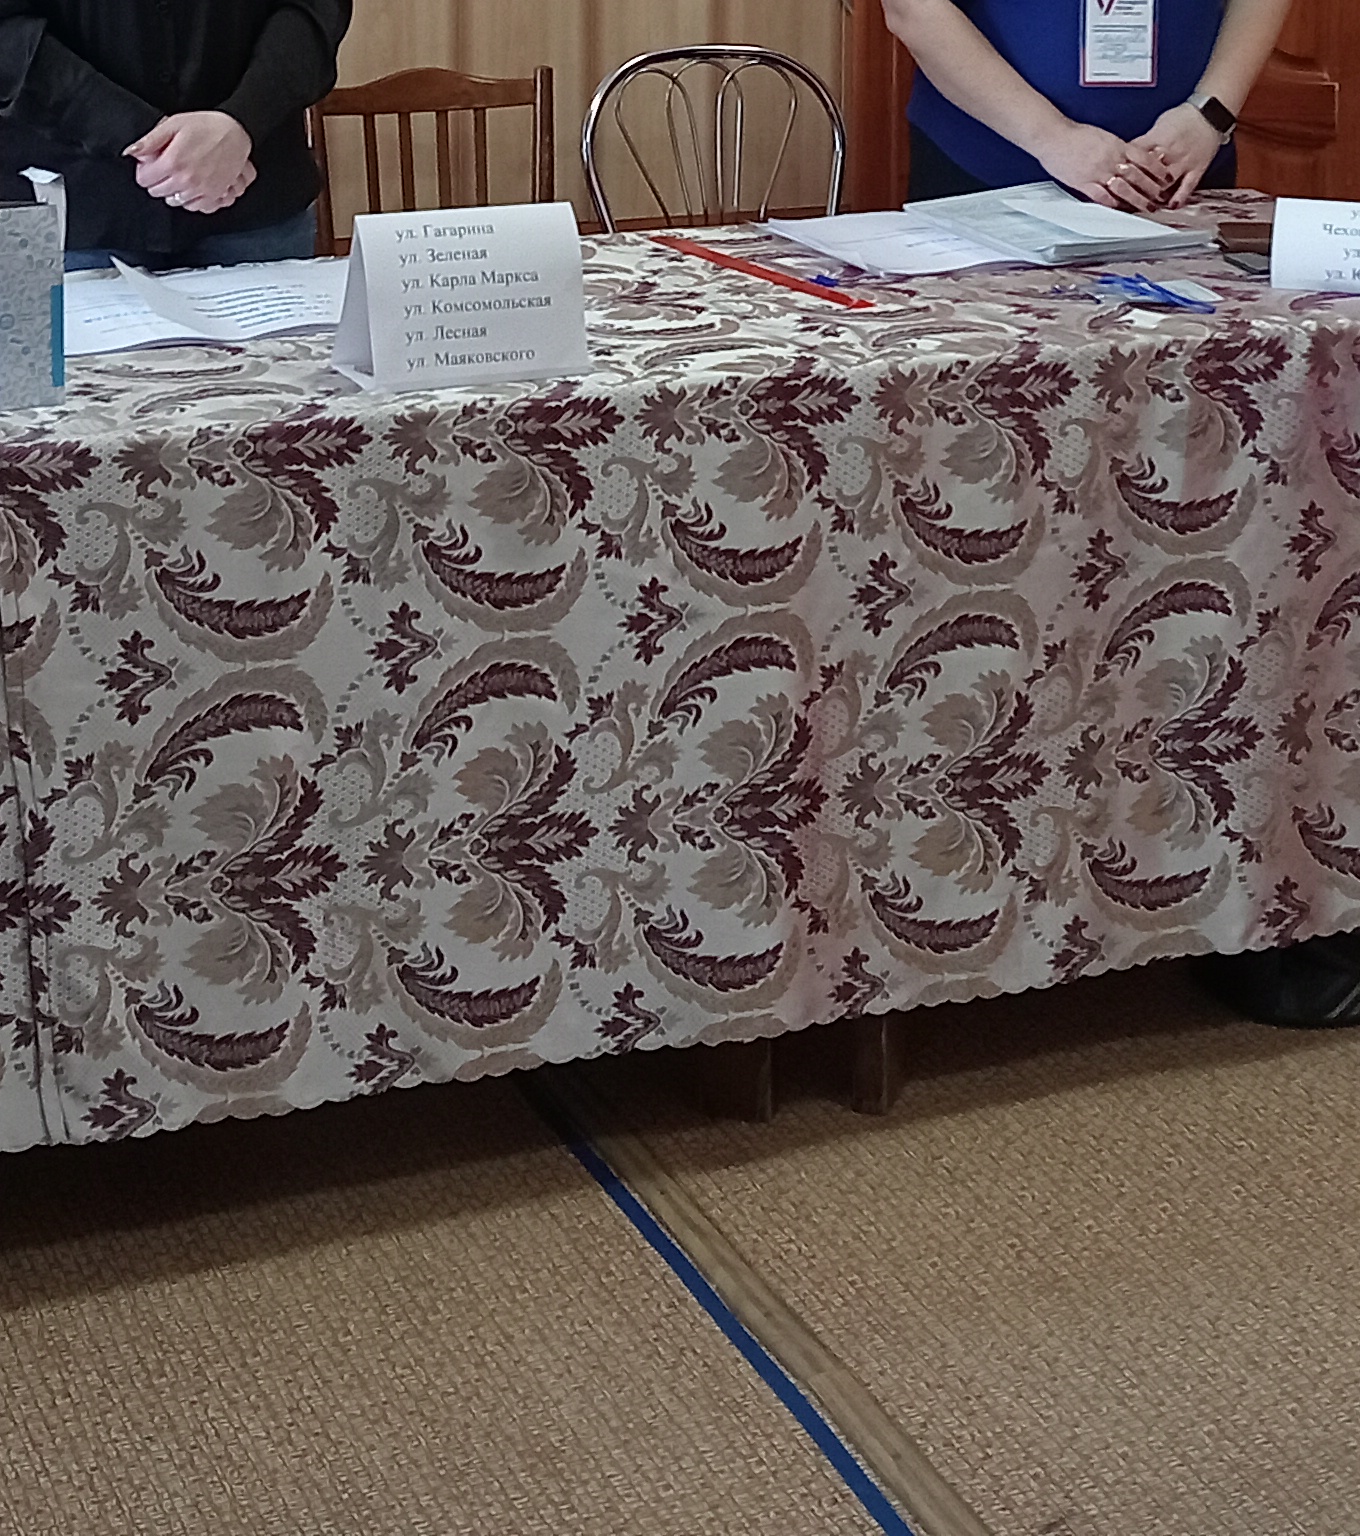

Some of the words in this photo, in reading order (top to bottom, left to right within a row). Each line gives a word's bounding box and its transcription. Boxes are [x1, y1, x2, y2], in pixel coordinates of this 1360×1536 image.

[395, 227, 417, 243] ул.
[422, 222, 495, 241] Гагарина
[426, 247, 489, 264] Зеленая
[401, 277, 423, 294] ул.
[429, 272, 477, 292] Карла
[480, 268, 540, 288] Маркса
[431, 294, 552, 315] Комсомольская
[432, 325, 488, 342] Лесная
[434, 346, 536, 368] Маяковского
